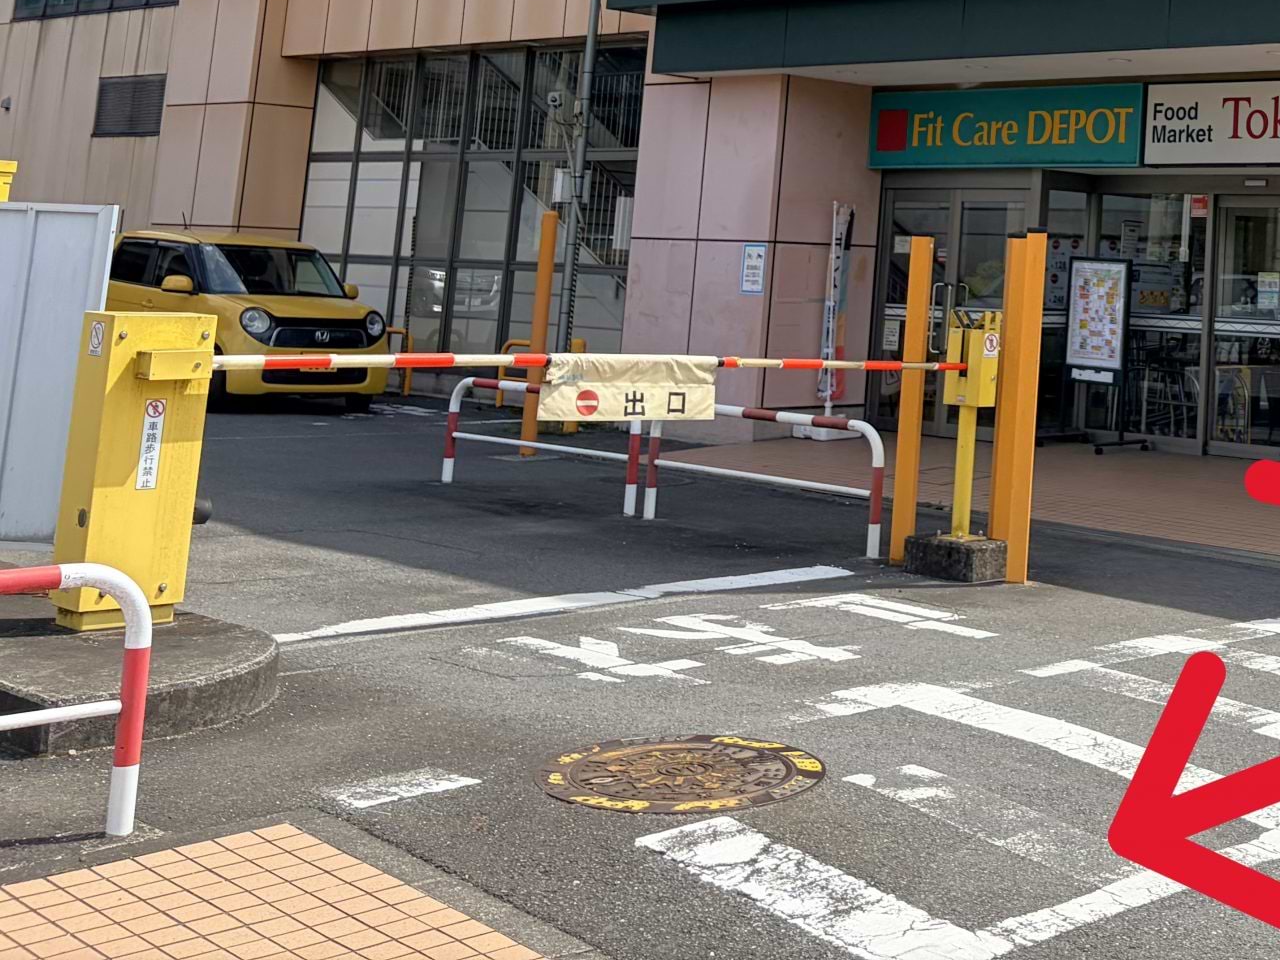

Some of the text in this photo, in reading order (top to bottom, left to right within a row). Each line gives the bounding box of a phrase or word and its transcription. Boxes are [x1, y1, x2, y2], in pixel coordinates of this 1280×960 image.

[1152, 102, 1199, 123] Food
[911, 107, 1134, 147] Fit Care DEPOT
[1151, 123, 1214, 144] Market
[624, 390, 686, 417] 出口
[140, 421, 159, 488] 車路歩行禁止
